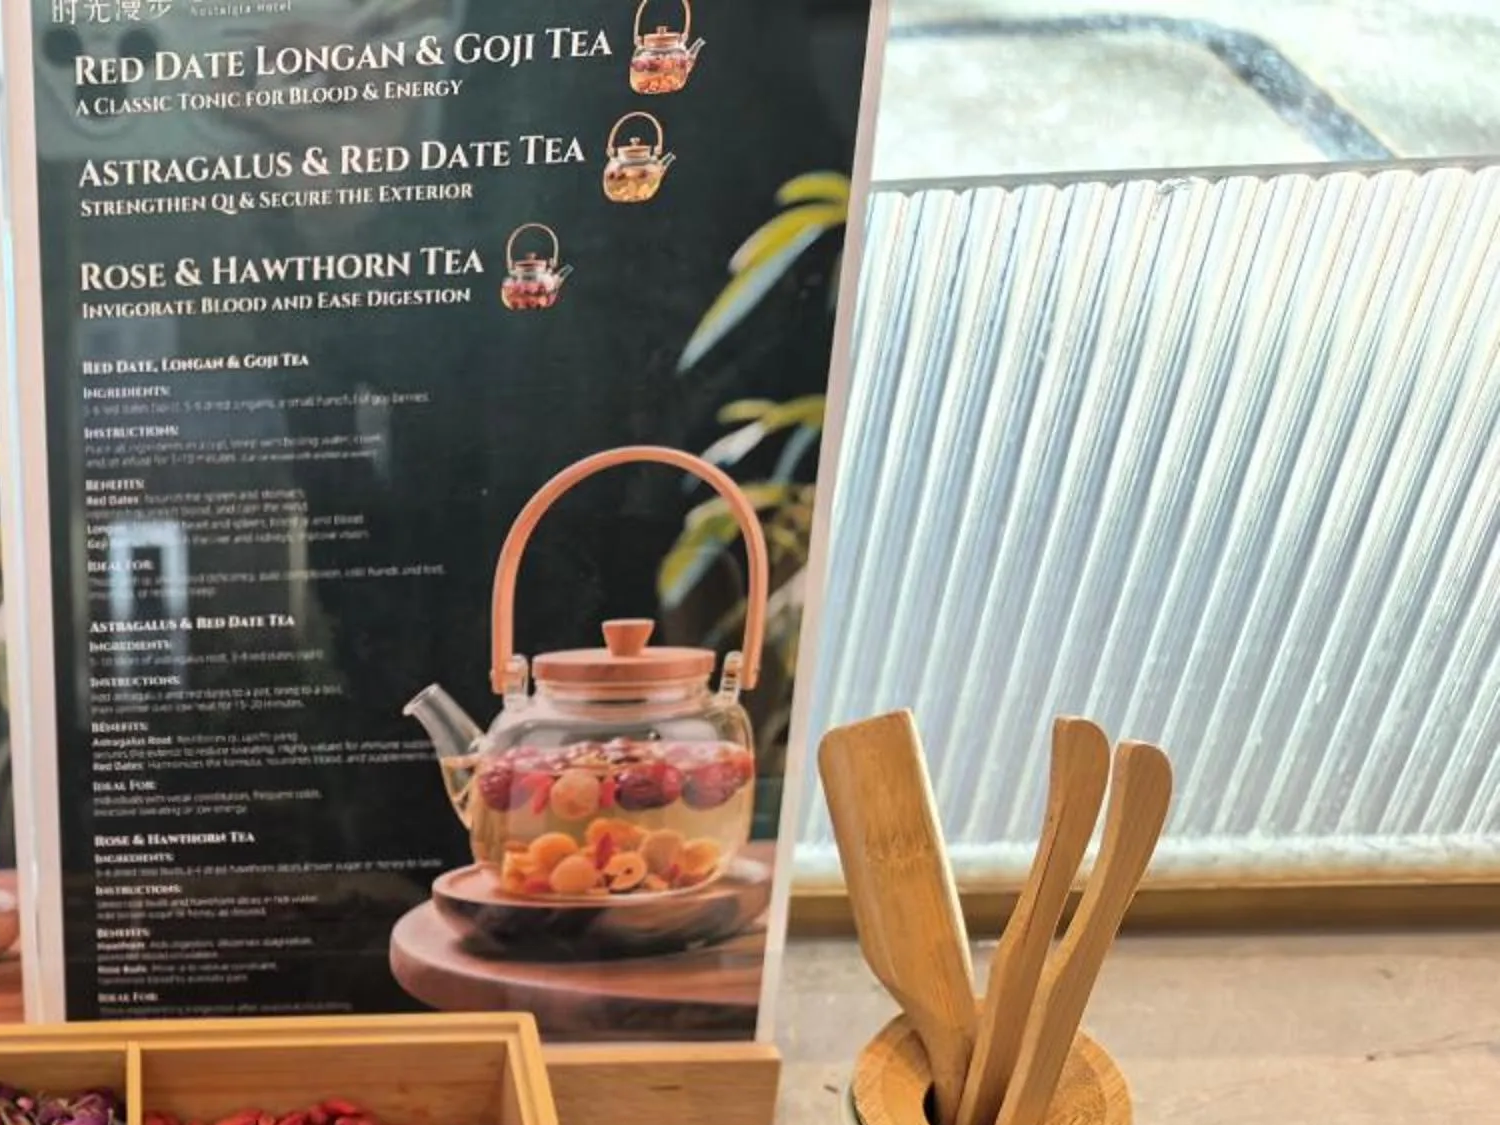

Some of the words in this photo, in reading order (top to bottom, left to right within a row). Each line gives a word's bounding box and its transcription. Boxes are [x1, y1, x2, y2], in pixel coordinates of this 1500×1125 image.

[75, 55, 145, 86] RED
[155, 51, 245, 82] DATE
[256, 41, 405, 77] LONGAN
[415, 35, 445, 66] &
[453, 33, 536, 68] GOJI
[545, 27, 613, 60] TEA
[75, 100, 90, 117] A
[93, 96, 172, 116] CLASSIC
[176, 92, 242, 112] TONIC
[245, 90, 285, 108] FOR
[289, 85, 358, 105] BLOOD
[362, 82, 380, 100] &
[385, 79, 464, 99] ENERGY
[78, 151, 293, 188] ASTRAGALUS
[301, 147, 328, 177] &
[340, 143, 410, 175] RED
[420, 139, 511, 172] DATE
[519, 135, 586, 165] TEA
[80, 196, 207, 217] STRENGTHEN
[211, 192, 238, 214] QI
[239, 192, 255, 211] &
[259, 188, 332, 210] SECURE
[336, 187, 374, 206] THE
[378, 181, 473, 203] EXTERIOR
[80, 260, 167, 292] ROSE
[175, 257, 204, 287] &
[212, 250, 411, 286] HAWTHORN
[421, 247, 485, 277] TEA
[81, 299, 197, 320] INVIGORATE
[200, 295, 267, 316] BLOOD
[270, 293, 313, 313] AND
[316, 290, 364, 310] EASE
[367, 286, 471, 308] DIGESTION
[83, 361, 113, 375] RED
[227, 354, 242, 369] &
[281, 352, 310, 367] TEA
